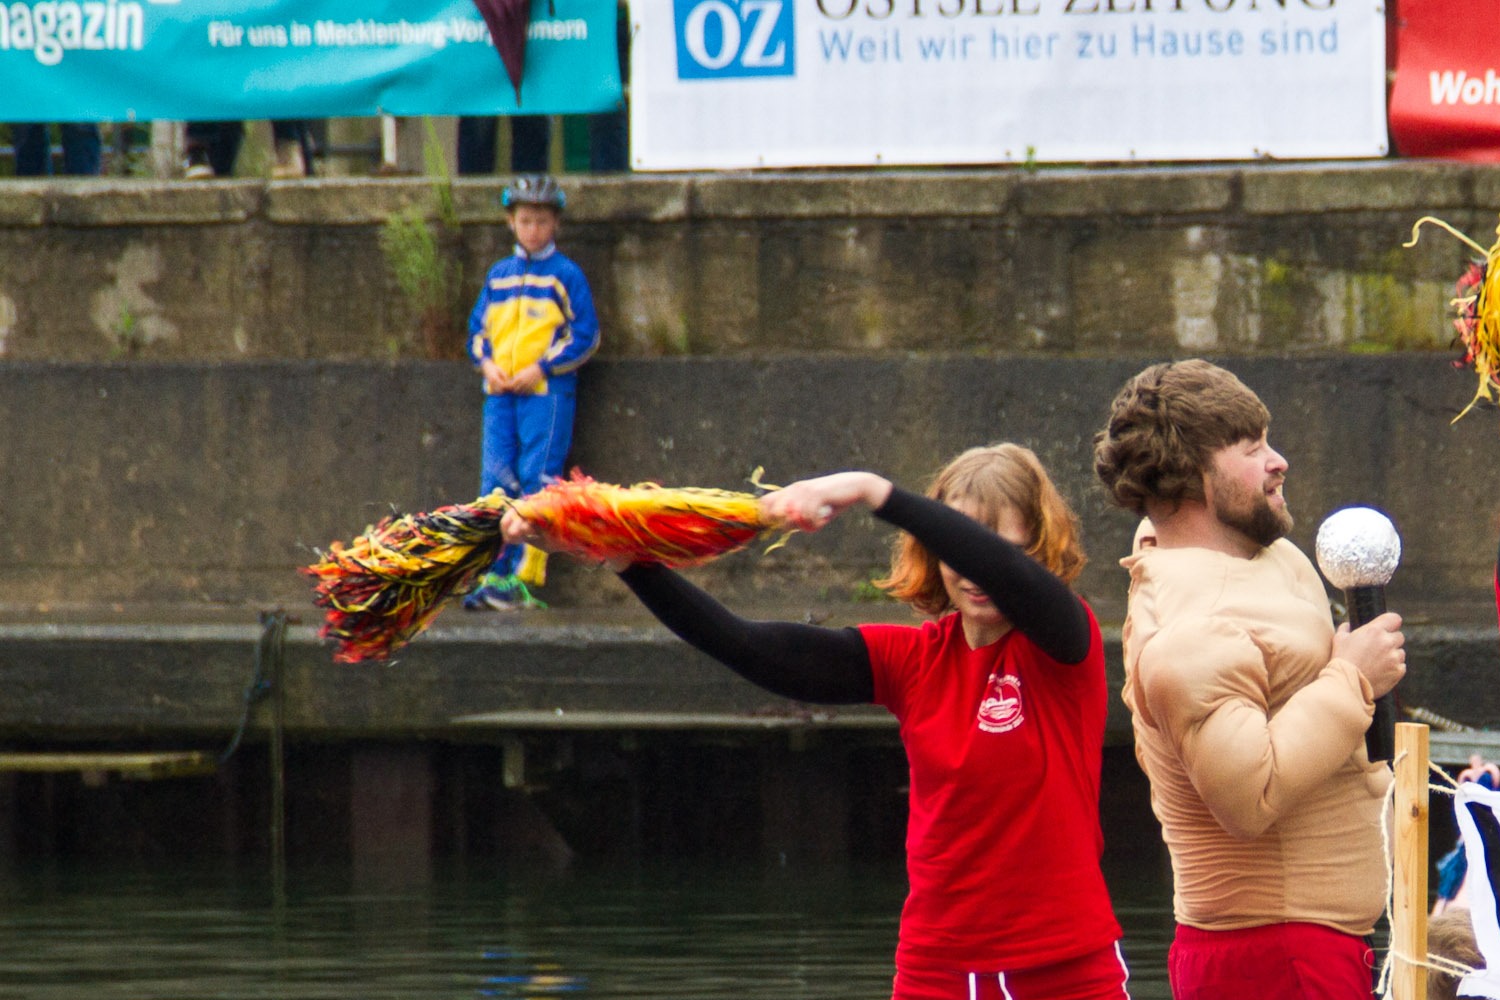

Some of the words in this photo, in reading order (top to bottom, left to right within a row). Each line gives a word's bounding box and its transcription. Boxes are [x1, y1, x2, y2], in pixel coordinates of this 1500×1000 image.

[207, 19, 244, 47] Für
[247, 24, 288, 48] uns
[290, 19, 312, 47] in
[314, 18, 587, 49] Mecklenburg-Vormern
[820, 26, 902, 62] Weil
[917, 28, 975, 61] wir
[990, 25, 1058, 60] hier
[1077, 30, 1116, 58] zu
[1131, 22, 1245, 57] Hause
[1260, 19, 1339, 56] sind
